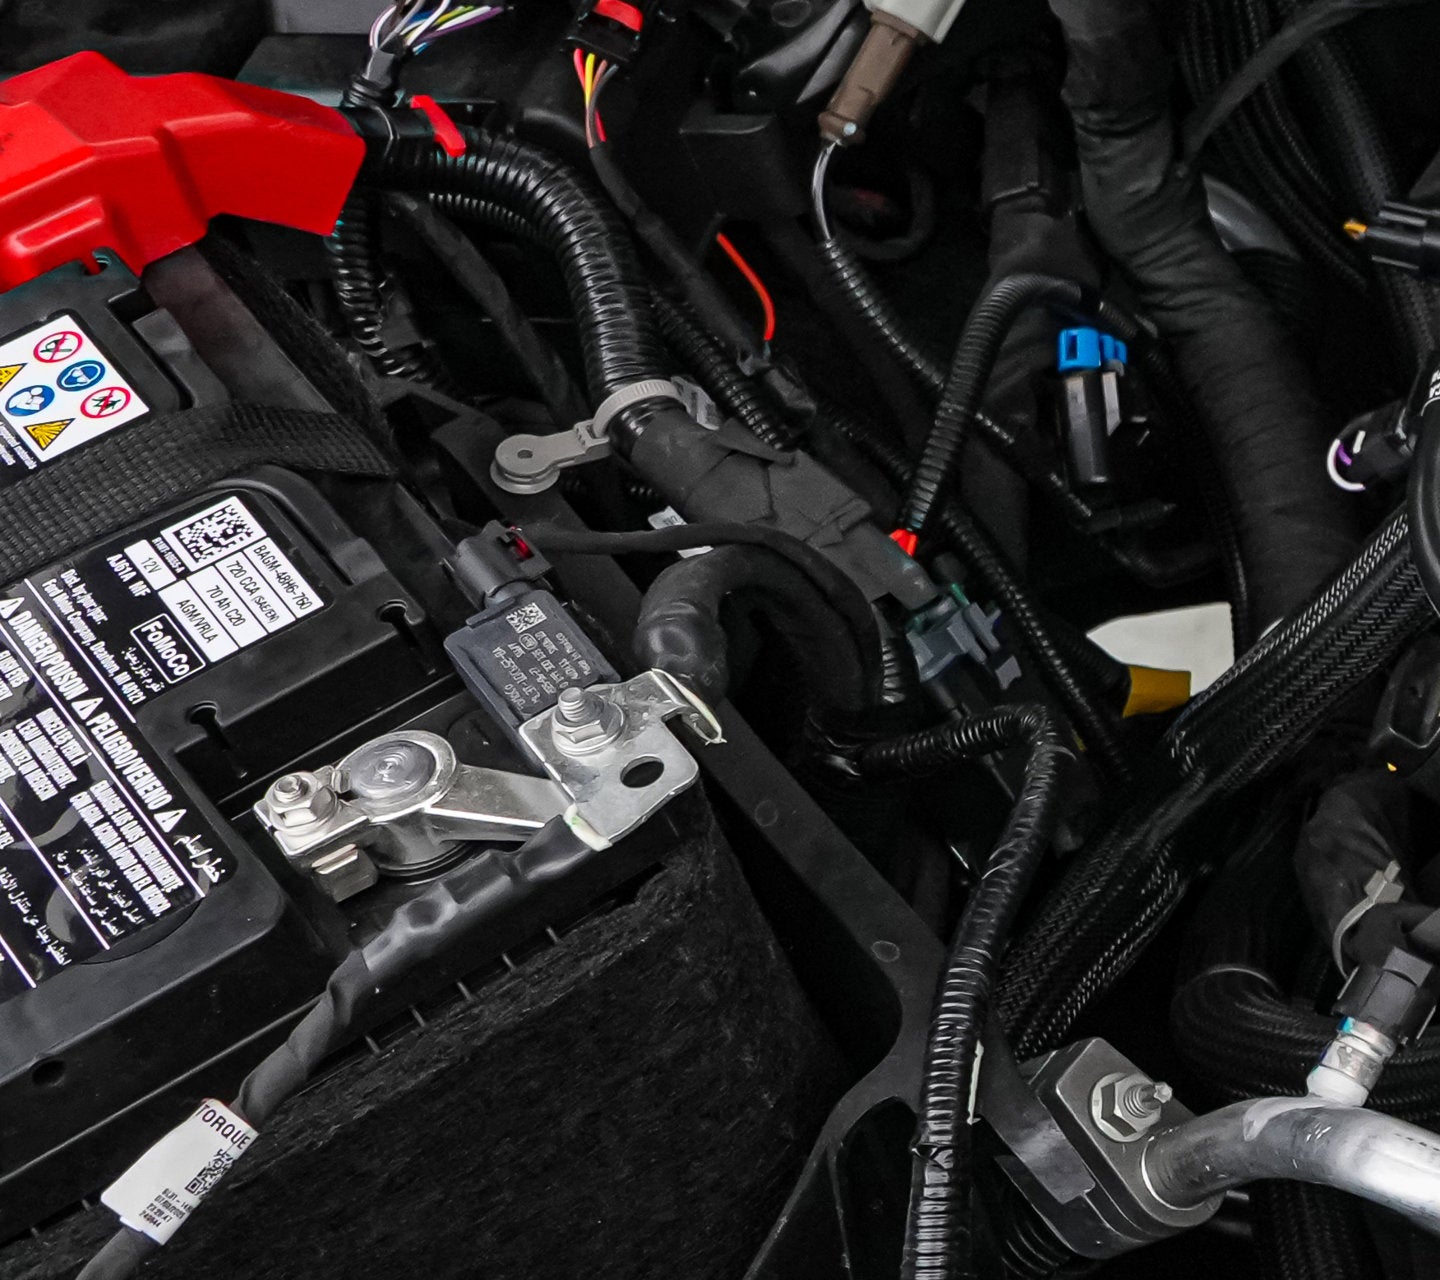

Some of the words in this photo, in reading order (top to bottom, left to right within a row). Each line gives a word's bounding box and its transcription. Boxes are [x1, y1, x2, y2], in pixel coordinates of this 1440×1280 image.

[58, 567, 84, 588] Dist.
[104, 551, 138, 583] AJ61A
[126, 579, 152, 600] MF
[139, 555, 162, 575] 12V
[252, 543, 313, 612] BAGM-48H6-760
[40, 577, 65, 598] Ford
[50, 591, 79, 616] Motor
[205, 584, 224, 599] 70
[214, 595, 234, 611] Ah
[225, 559, 247, 579] 720
[238, 575, 261, 596] CCA
[250, 593, 281, 624] (SAE/EN)
[62, 609, 102, 648] Company,
[175, 597, 219, 644] AGM/VRLA
[223, 607, 247, 627] C20
[86, 640, 125, 678] Dearborn,
[139, 619, 196, 677] FoMoCo
[110, 670, 132, 686] MI
[118, 679, 147, 706] 48121
[8, 611, 89, 701] DANGER/POISON
[80, 711, 174, 812] PELIGRO/VENENO
[197, 1103, 251, 1150] TORQUE
